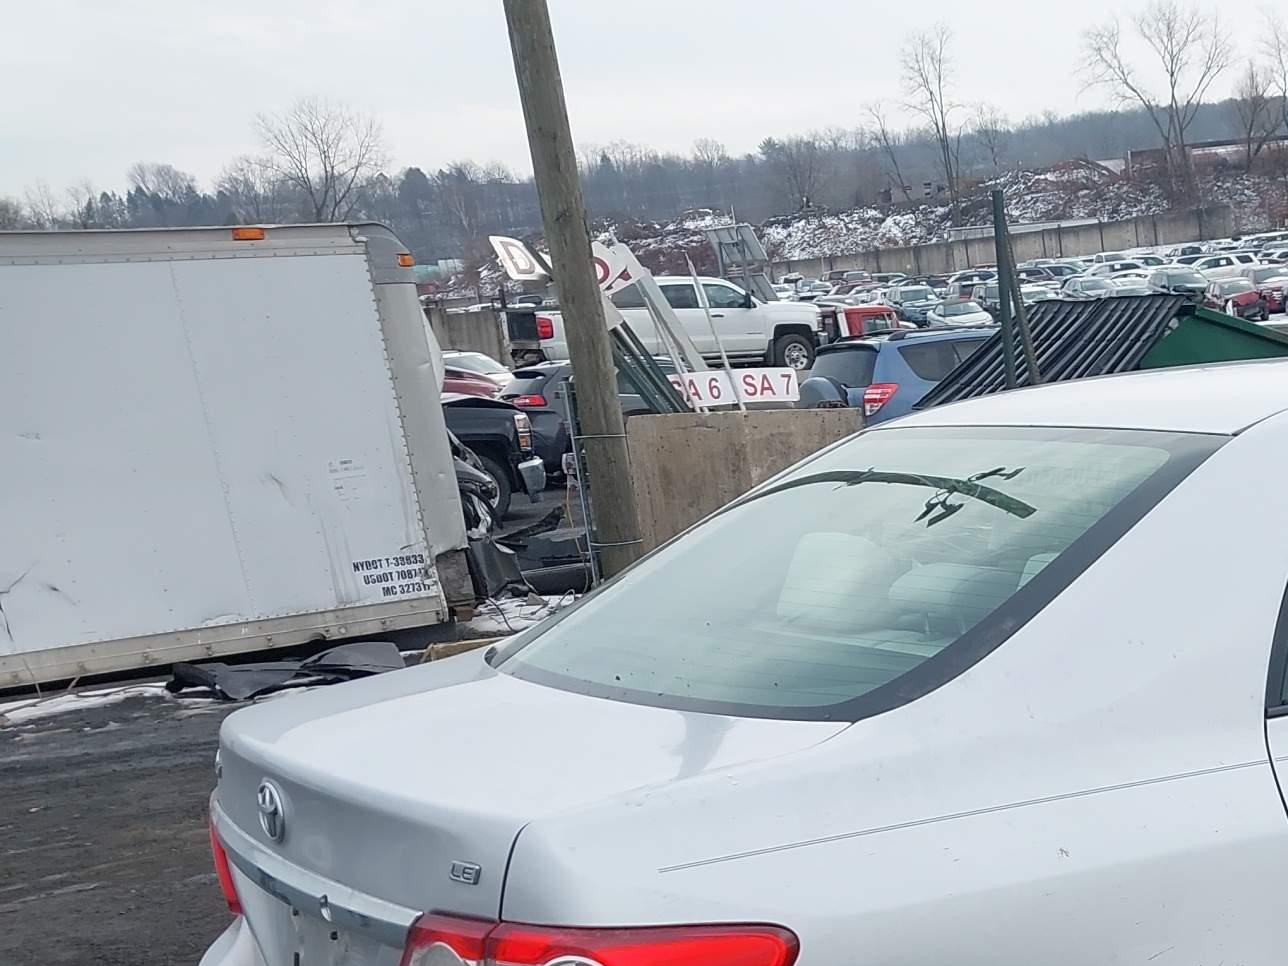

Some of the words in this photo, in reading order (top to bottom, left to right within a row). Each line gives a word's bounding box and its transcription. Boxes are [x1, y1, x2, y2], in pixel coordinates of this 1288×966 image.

[708, 377, 721, 400] 6
[742, 373, 776, 397] SA
[780, 373, 792, 396] 7
[352, 558, 383, 572] NYDOT
[363, 571, 394, 585] USDOT
[381, 585, 398, 597] MC
[450, 861, 478, 883] LE
